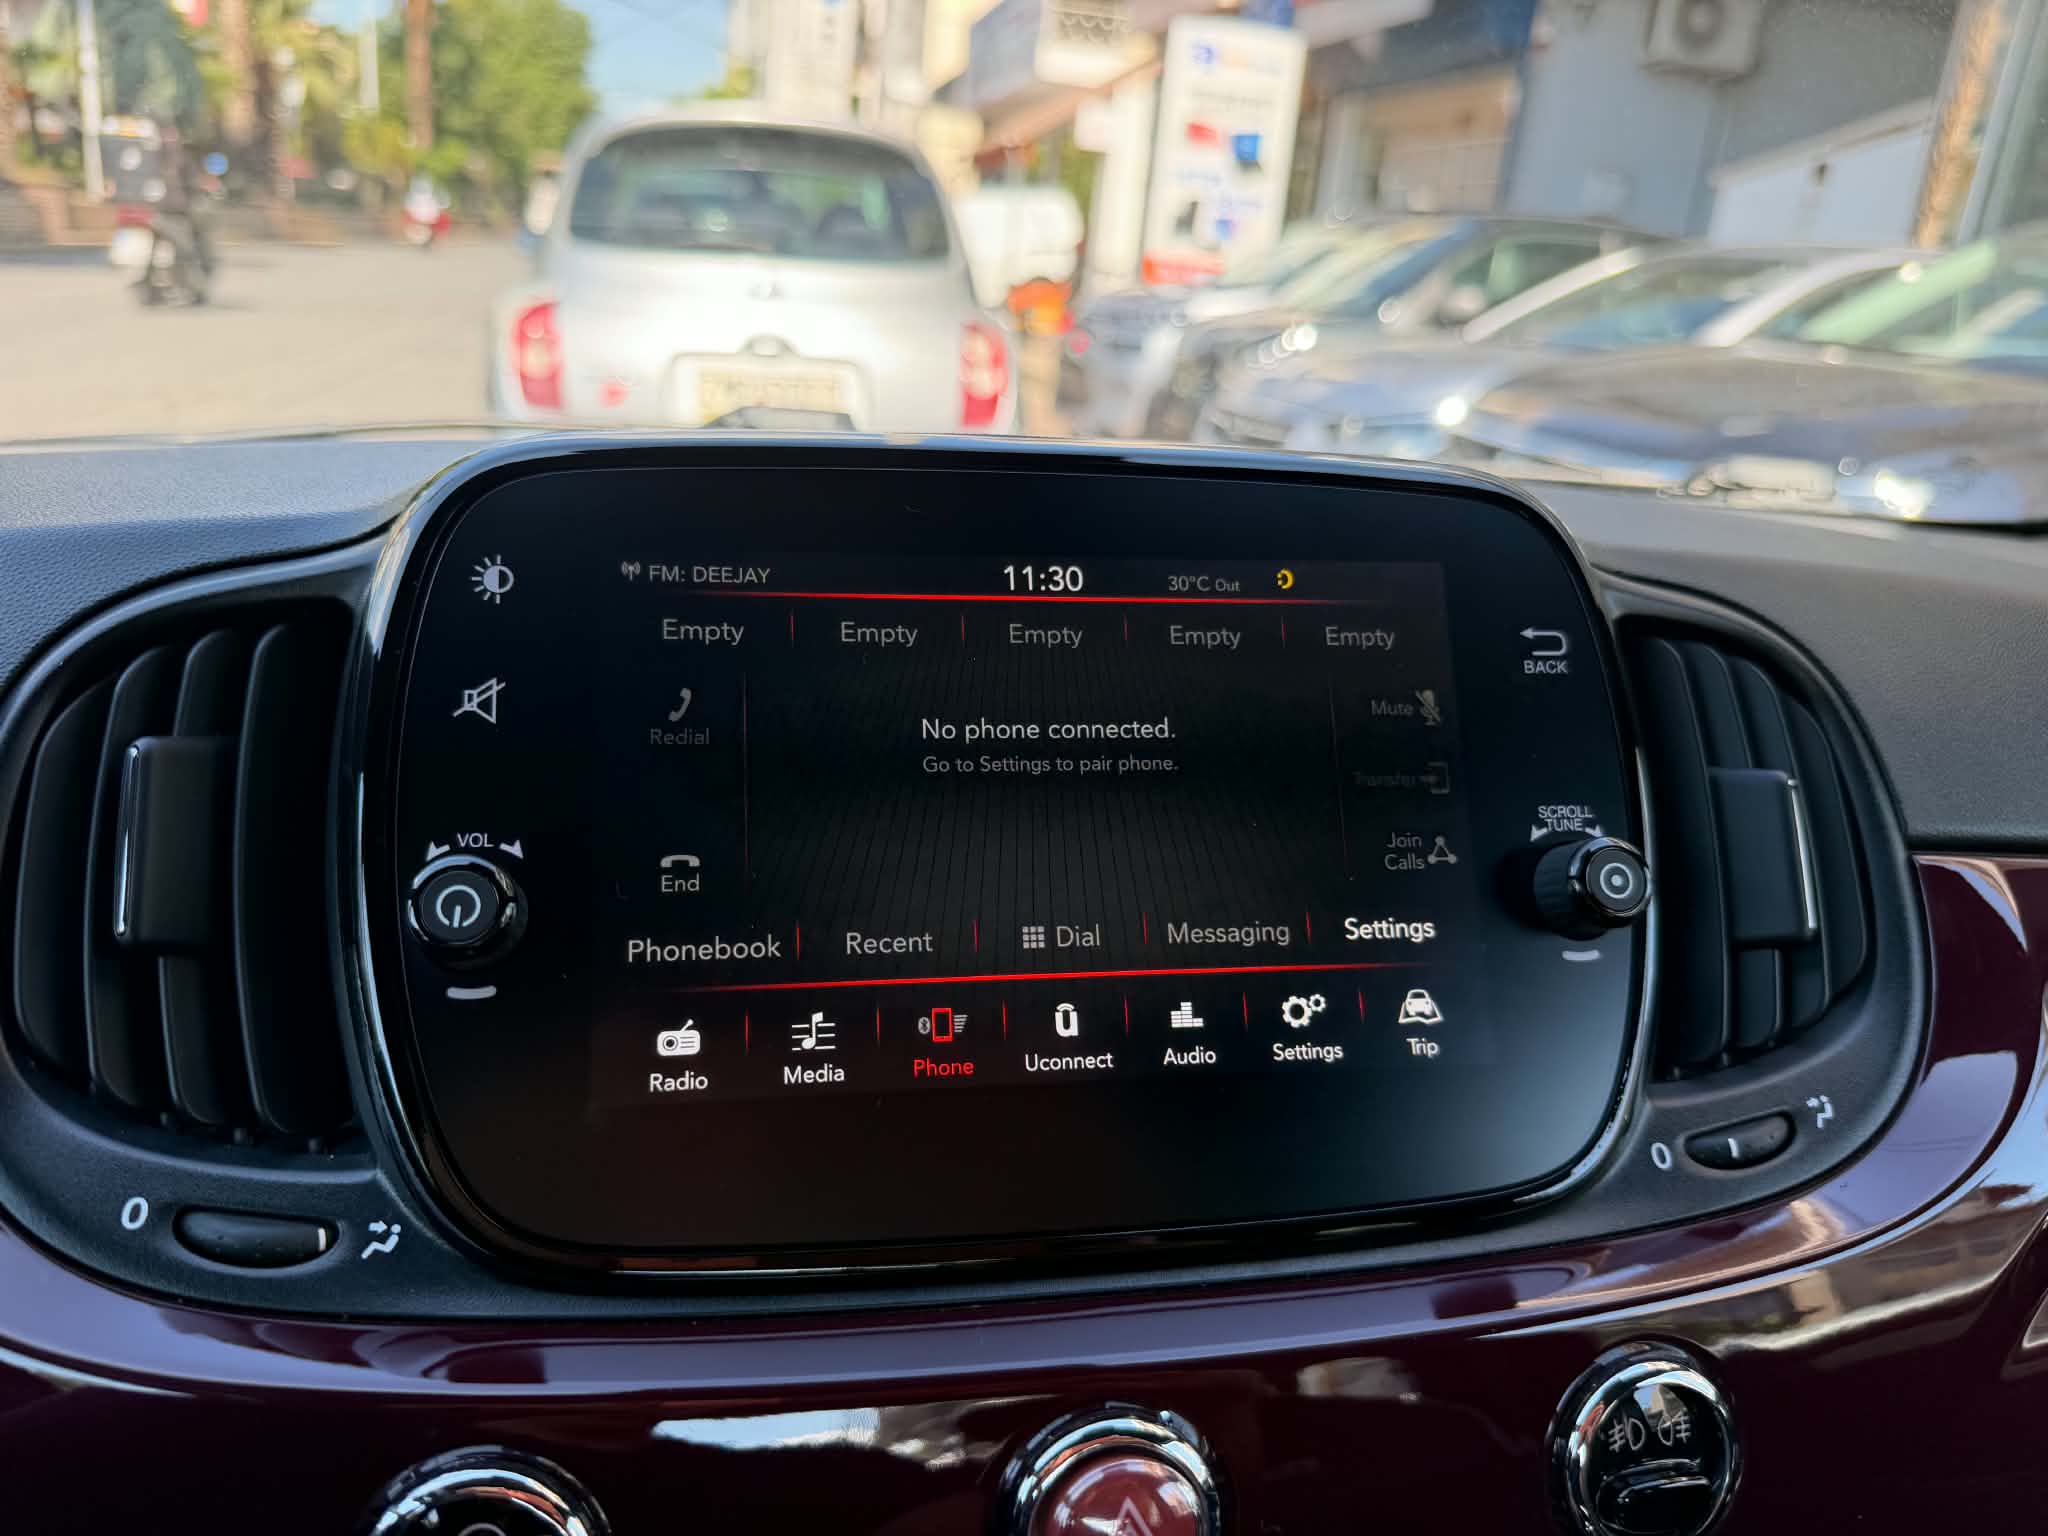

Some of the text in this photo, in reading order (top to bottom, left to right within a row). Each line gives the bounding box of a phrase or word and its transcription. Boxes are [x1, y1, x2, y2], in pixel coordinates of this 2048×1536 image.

[649, 566, 770, 584] FM: DEEJAY
[1003, 566, 1083, 591] 11:30
[1168, 576, 1240, 592] 30°C Out
[662, 619, 744, 645] Empty
[840, 622, 918, 647] Empty
[1009, 624, 1083, 648] Empty
[1169, 626, 1241, 649] Empty
[1325, 627, 1395, 650] Empty
[1524, 660, 1567, 674] BACK
[1371, 700, 1414, 716] Mute
[650, 729, 710, 745] Redial
[921, 717, 1176, 744] No phone connected.
[922, 755, 1179, 775] Go to Settings to pair phone.
[1537, 805, 1593, 818] SCROLL
[1544, 818, 1584, 832] TUNE
[457, 833, 494, 847] VOL
[1387, 833, 1422, 848] Join
[1385, 855, 1424, 870] Calls
[661, 874, 700, 892] End
[1057, 925, 1100, 947] Dial
[1168, 921, 1290, 945] Messaging
[1344, 917, 1436, 942] Settings
[627, 934, 782, 962] Phonebook
[846, 931, 933, 955] Recent
[1163, 1047, 1216, 1065] Audio
[1273, 1041, 1343, 1062] Settings
[1407, 1038, 1440, 1058] Trip
[914, 1059, 974, 1077] Phone
[1025, 1053, 1114, 1071] Uconnect
[649, 1072, 708, 1092] Radio
[784, 1065, 845, 1084] Media
